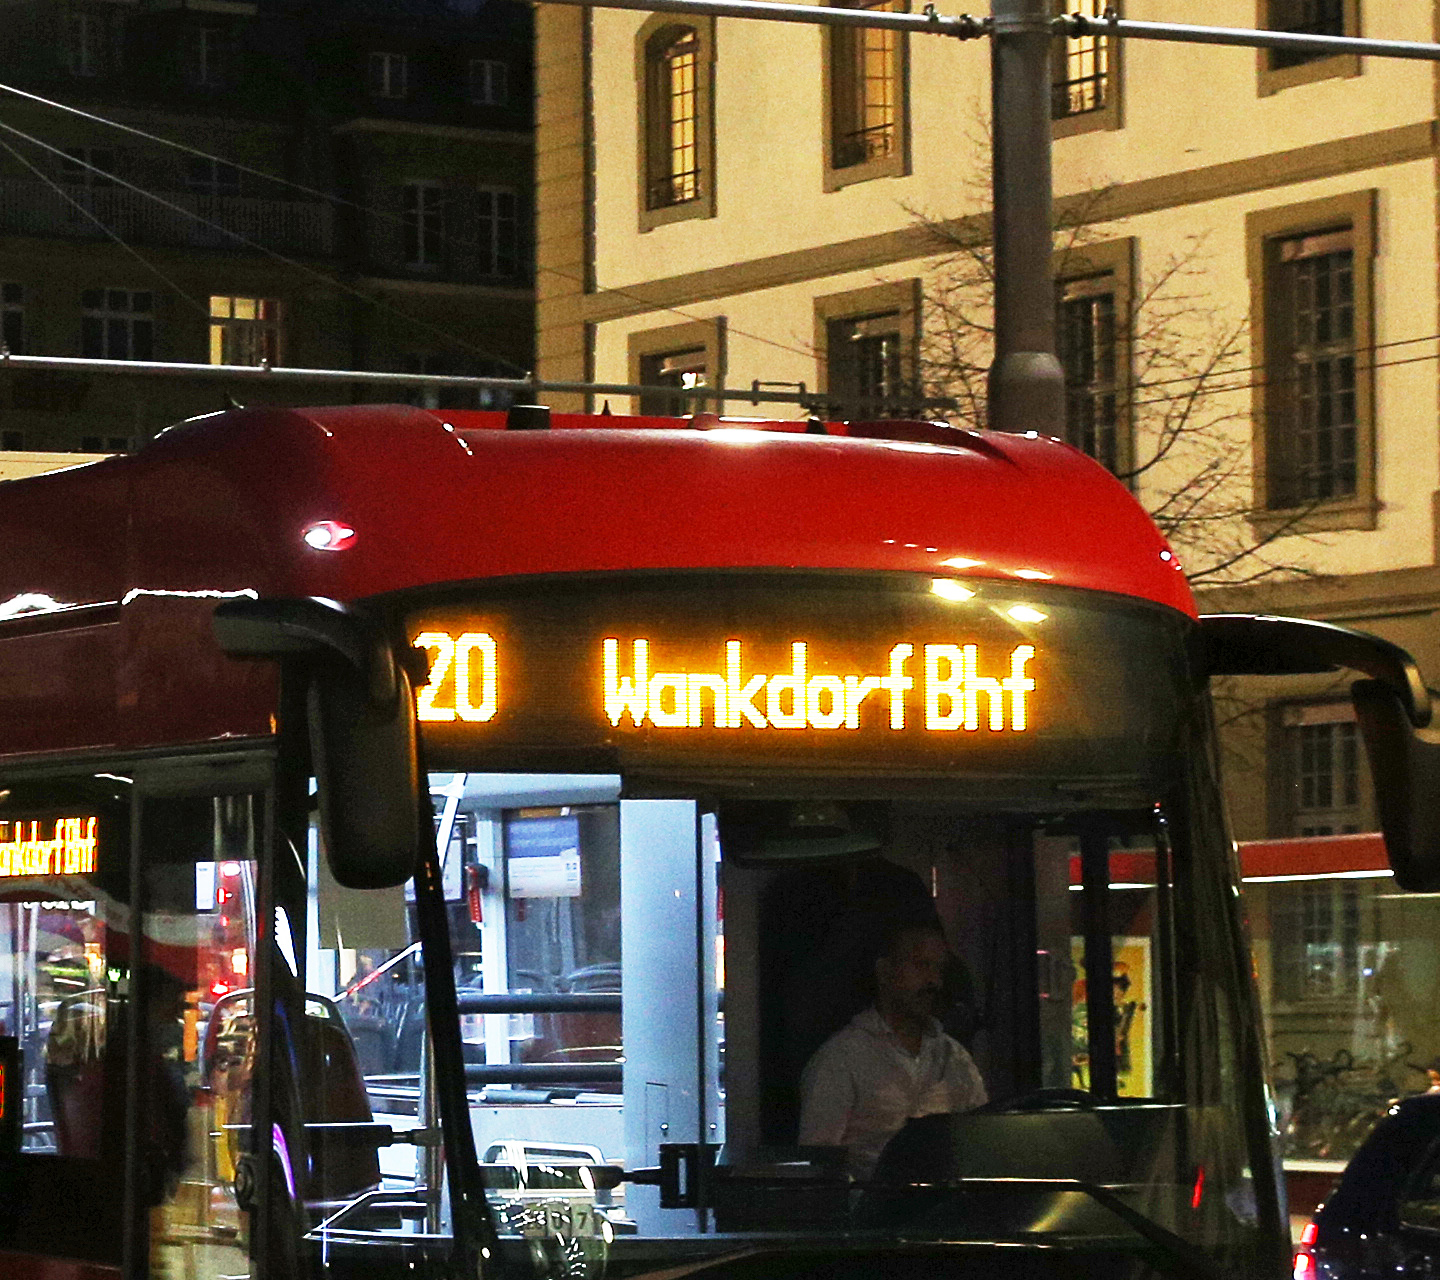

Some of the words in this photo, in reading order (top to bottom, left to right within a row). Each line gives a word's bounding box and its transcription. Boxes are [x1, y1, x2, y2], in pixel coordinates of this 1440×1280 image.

[413, 631, 498, 723] 20
[602, 637, 914, 731] Wankdorf
[923, 643, 1036, 733] Bhf
